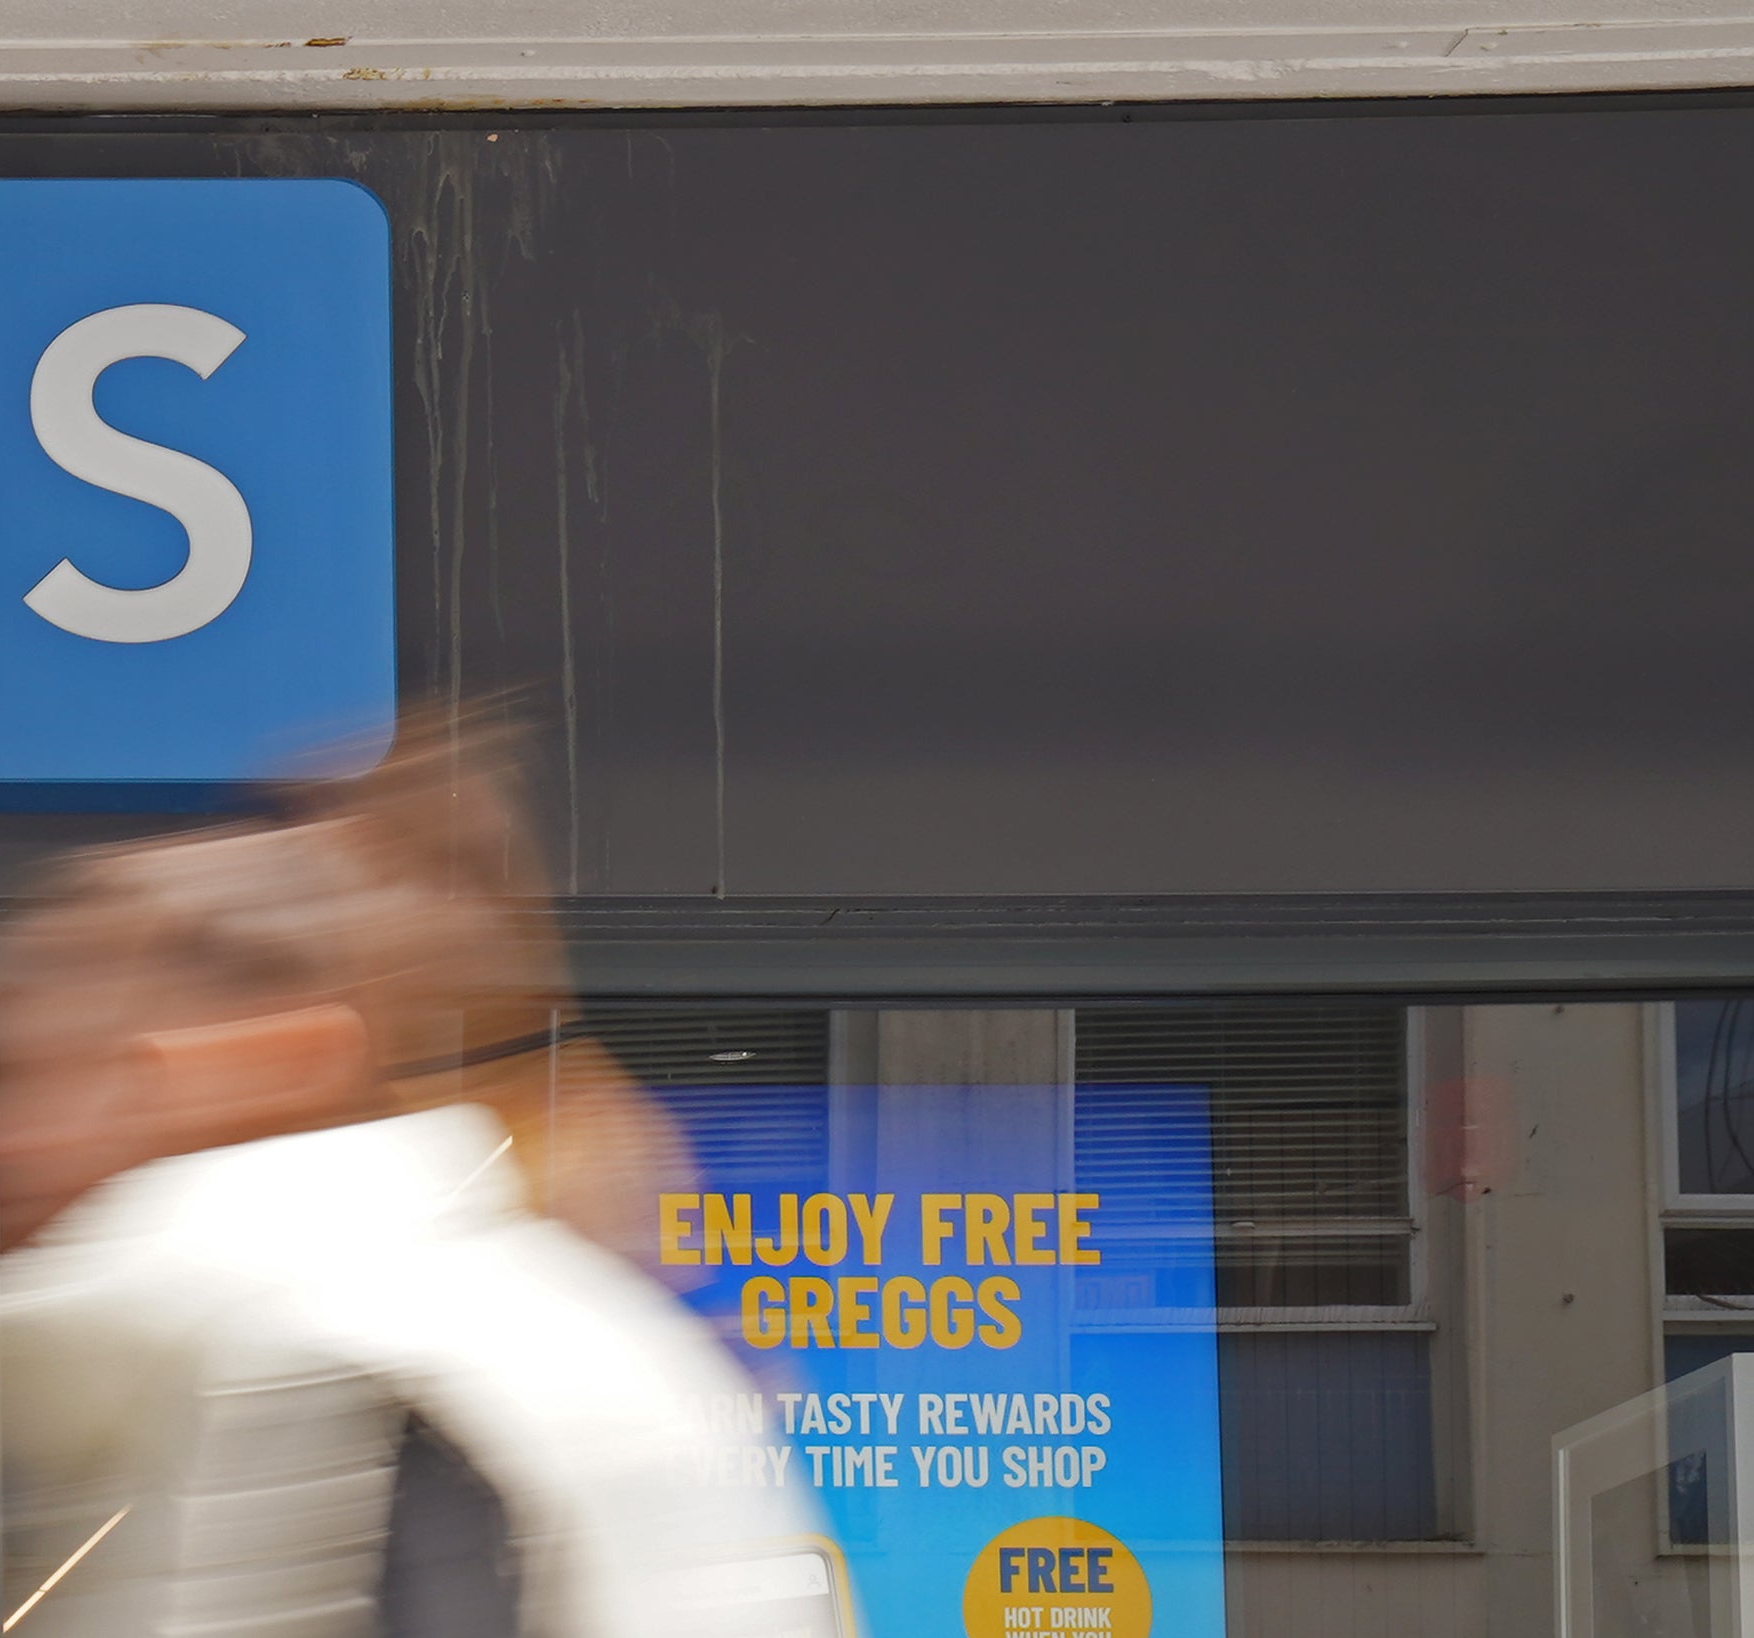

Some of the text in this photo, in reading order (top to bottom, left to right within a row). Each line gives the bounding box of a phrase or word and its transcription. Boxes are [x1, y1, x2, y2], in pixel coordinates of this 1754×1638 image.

[659, 1193, 1102, 1266] ENJOY FREE
[741, 1275, 1022, 1350] GREGGS
[777, 1393, 903, 1435] TASTY
[918, 1393, 1112, 1436] REWARDS
[806, 1445, 899, 1488] TIME
[911, 1445, 989, 1488] YOU
[1003, 1445, 1107, 1488] SHOP
[998, 1547, 1115, 1594] FREE
[1004, 1607, 1112, 1629] HOT DRINK
